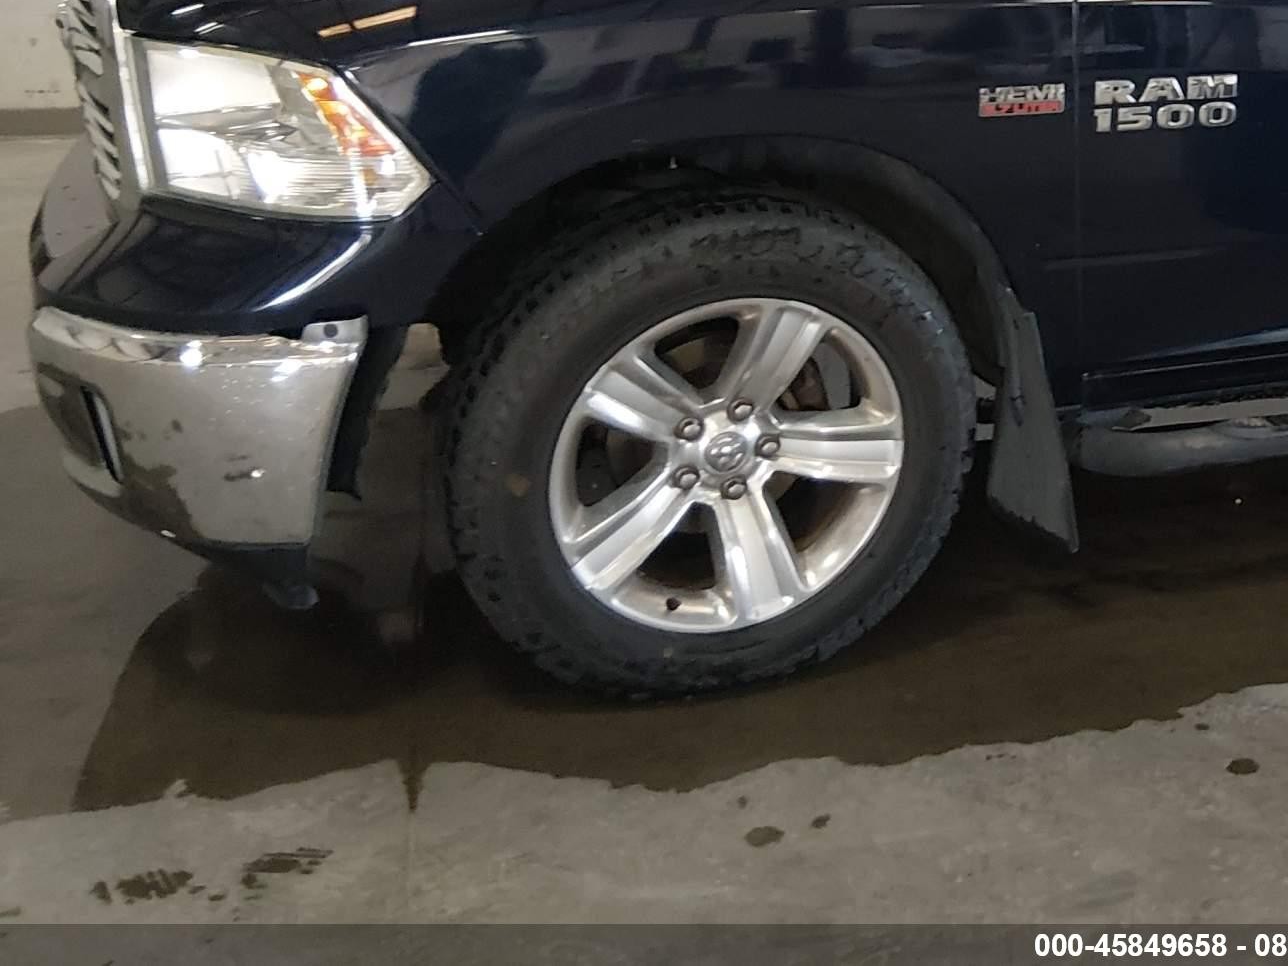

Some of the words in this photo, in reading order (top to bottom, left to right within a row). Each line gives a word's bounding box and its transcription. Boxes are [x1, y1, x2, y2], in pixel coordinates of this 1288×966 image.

[979, 83, 1066, 104] HEMI
[1094, 73, 1238, 106] RAM
[1093, 101, 1238, 133] 1500
